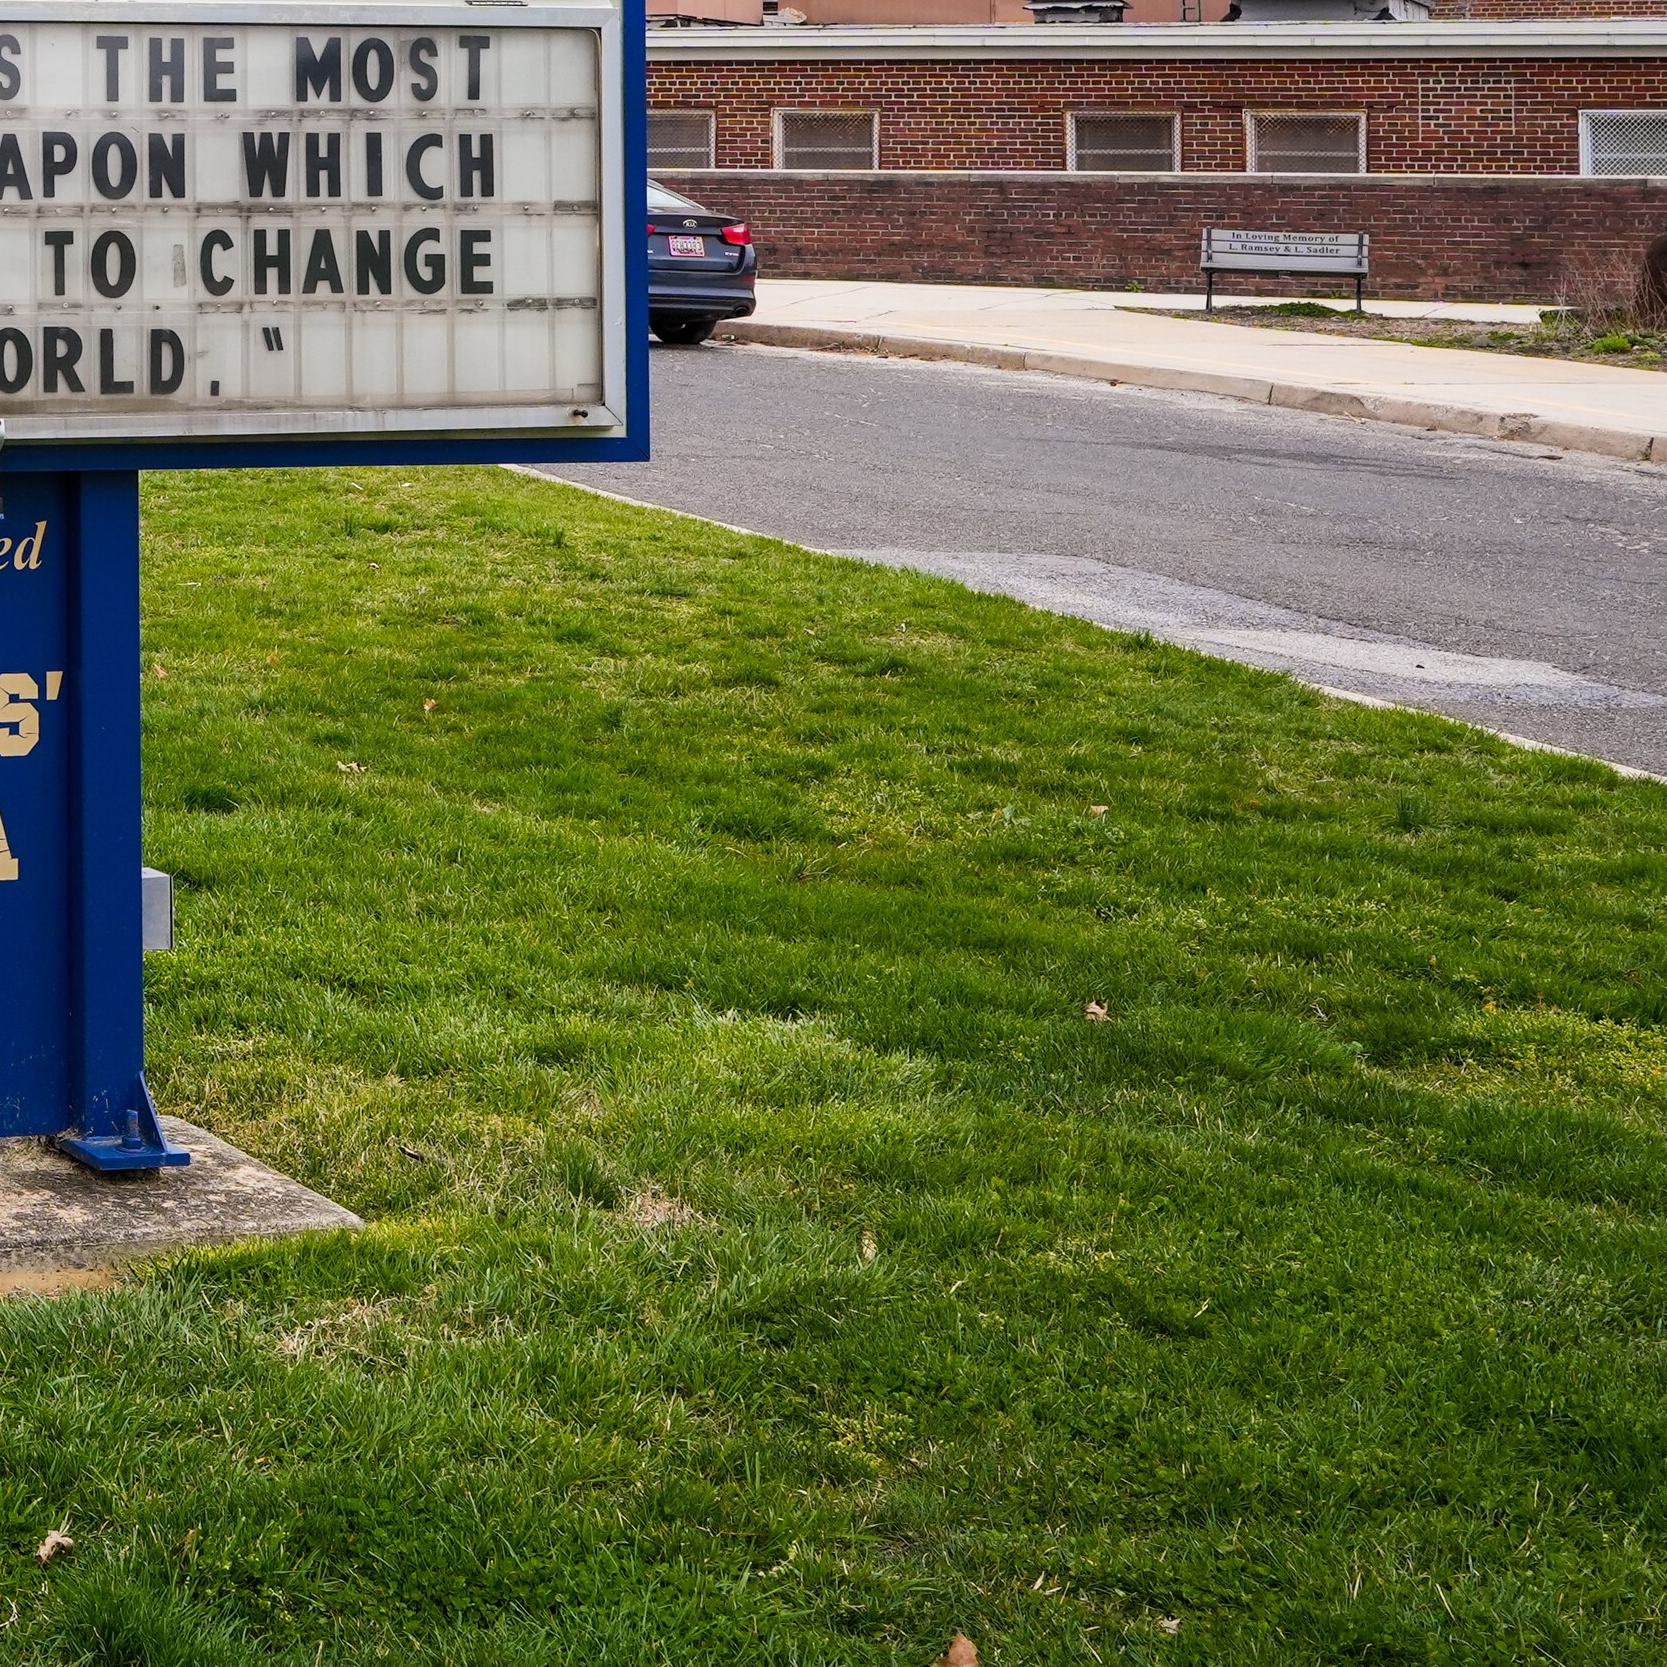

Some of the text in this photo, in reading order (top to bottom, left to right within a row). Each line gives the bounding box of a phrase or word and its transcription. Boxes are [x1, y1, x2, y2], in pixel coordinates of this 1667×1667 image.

[97, 36, 238, 103] THE
[295, 34, 492, 104] MOST
[242, 131, 496, 202] WHICH
[44, 230, 137, 300] TO
[199, 227, 495, 297] CHANGE
[1241, 244, 1280, 253] Ramsey
[1306, 246, 1340, 254] Sadler
[1245, 233, 1280, 242] Loving
[1283, 235, 1324, 244] Memory
